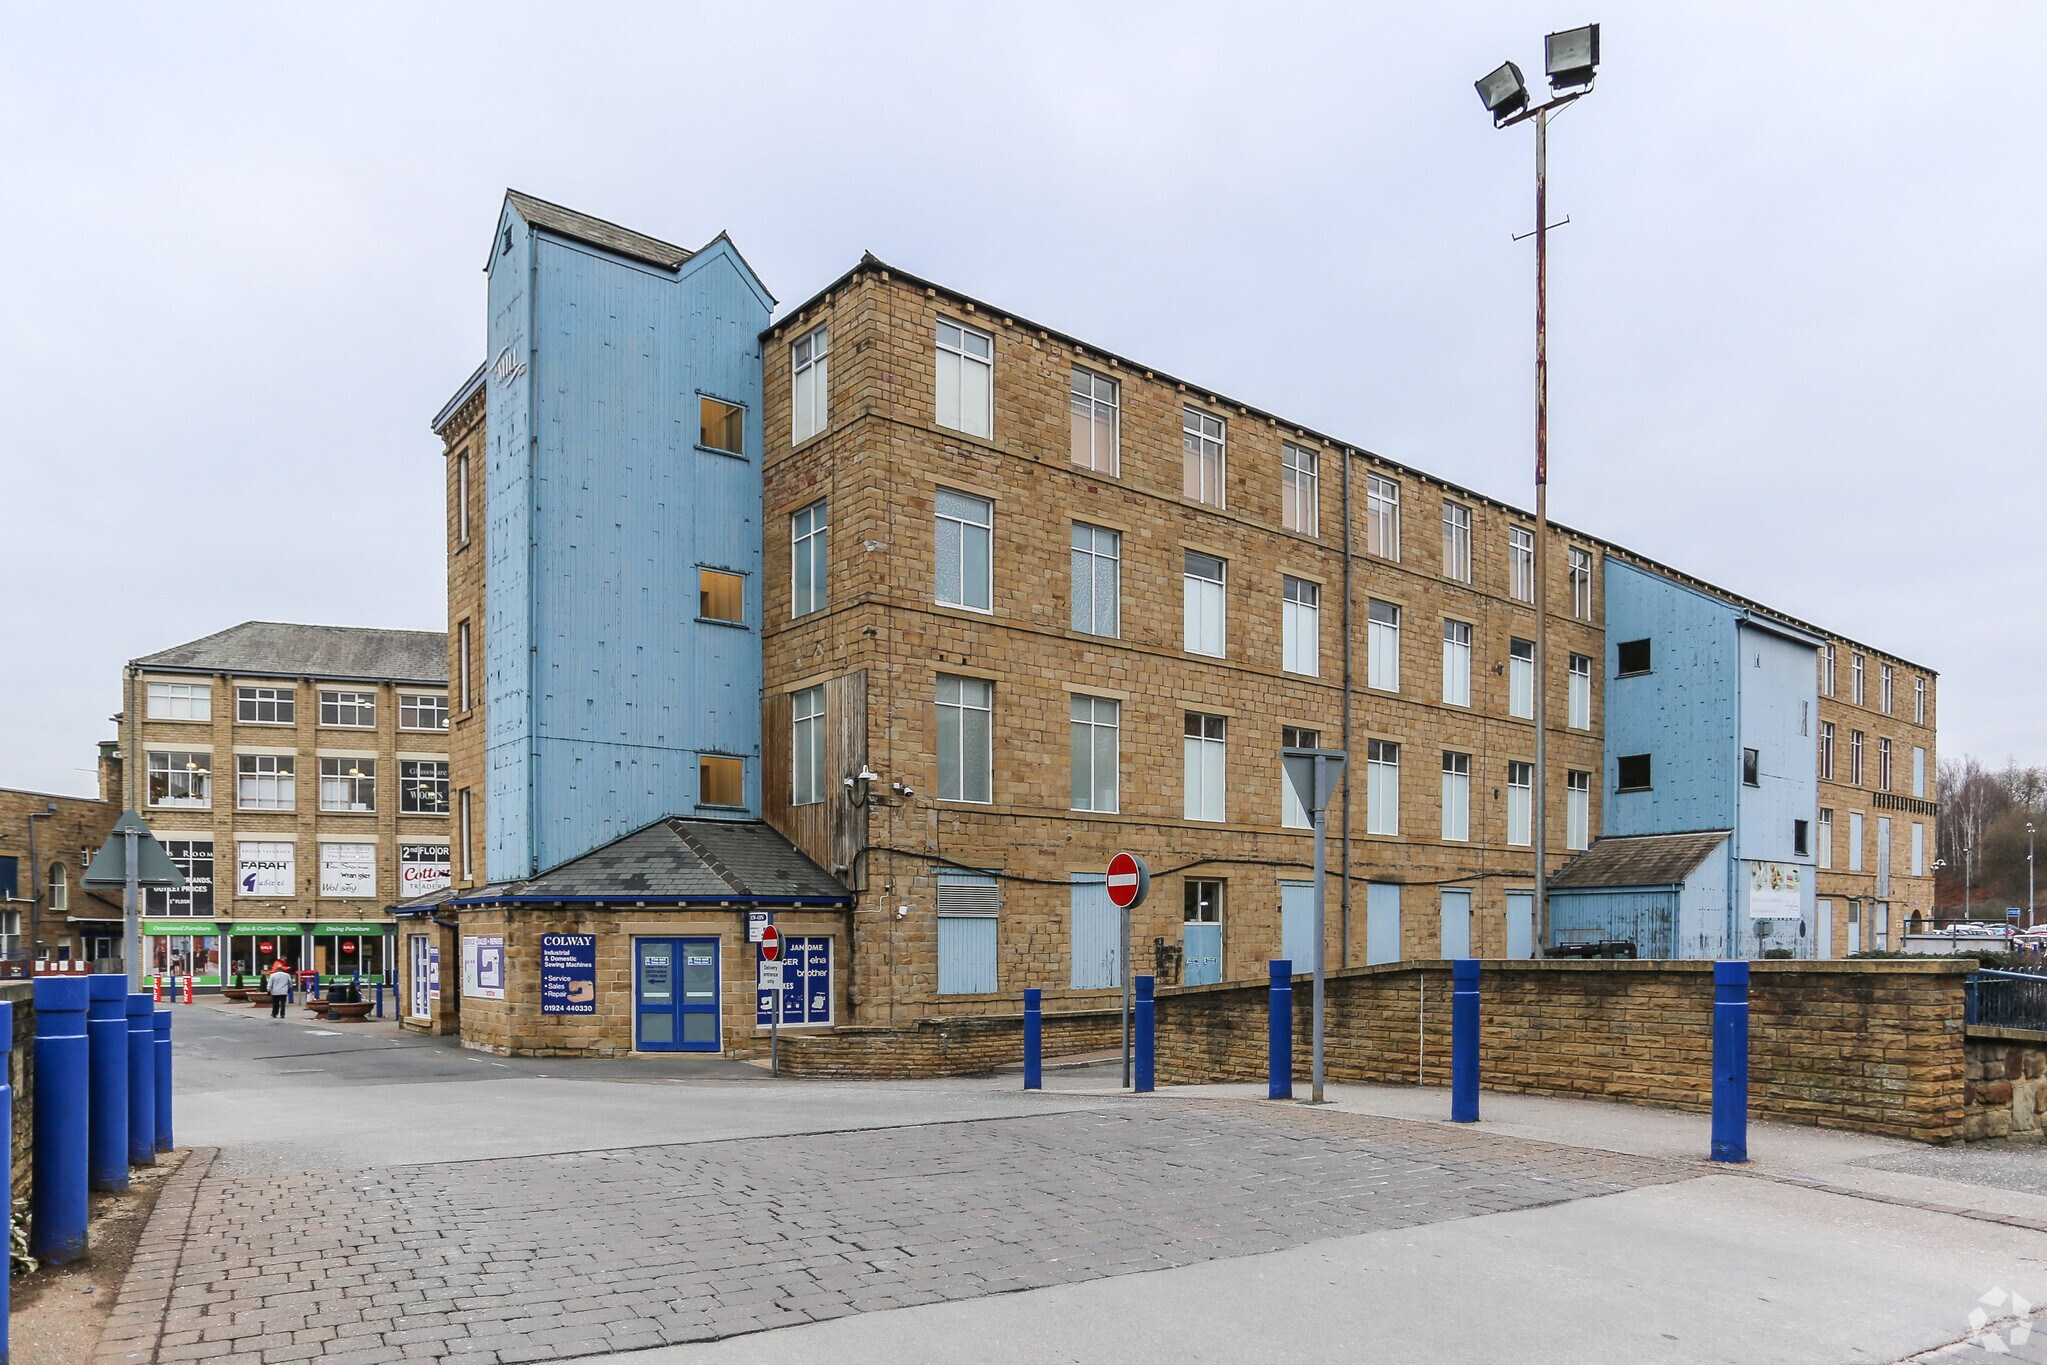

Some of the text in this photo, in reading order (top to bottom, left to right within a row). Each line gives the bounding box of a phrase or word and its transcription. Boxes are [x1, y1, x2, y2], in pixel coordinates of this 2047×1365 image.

[403, 847, 450, 858] 2nd FLOOR
[240, 861, 287, 870] FARAH
[544, 937, 592, 946] COLWAY
[797, 969, 827, 977] brother
